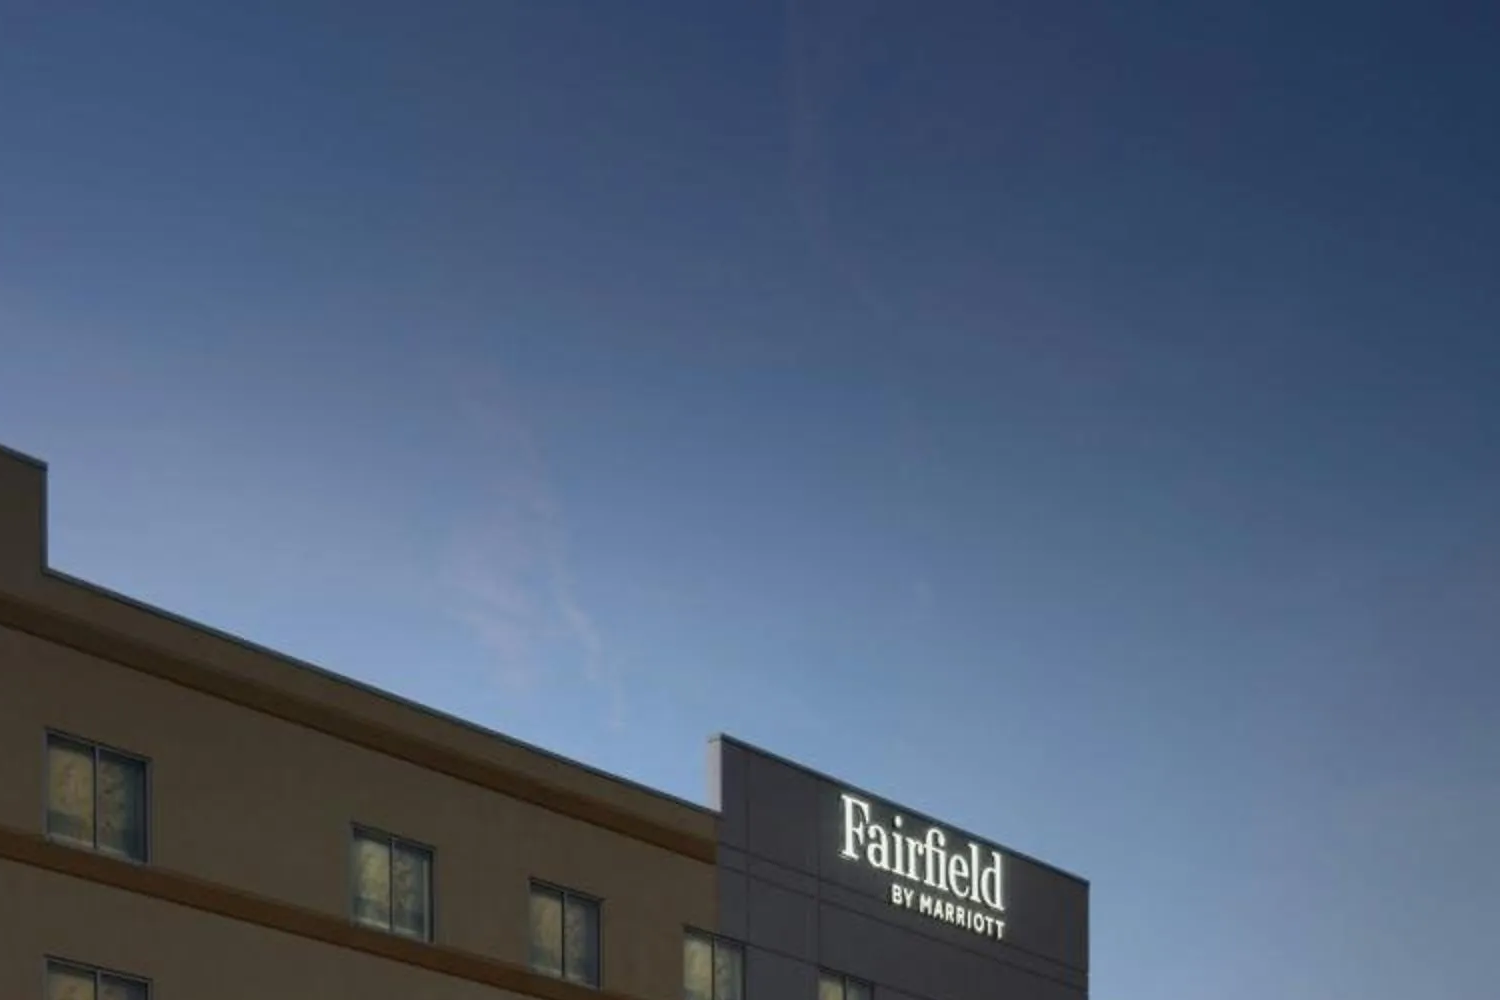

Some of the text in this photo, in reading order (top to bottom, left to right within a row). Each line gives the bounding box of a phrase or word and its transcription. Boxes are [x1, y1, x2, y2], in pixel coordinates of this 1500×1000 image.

[841, 793, 1005, 911] Fairfield
[891, 884, 1006, 940] BY MARRIOTT
